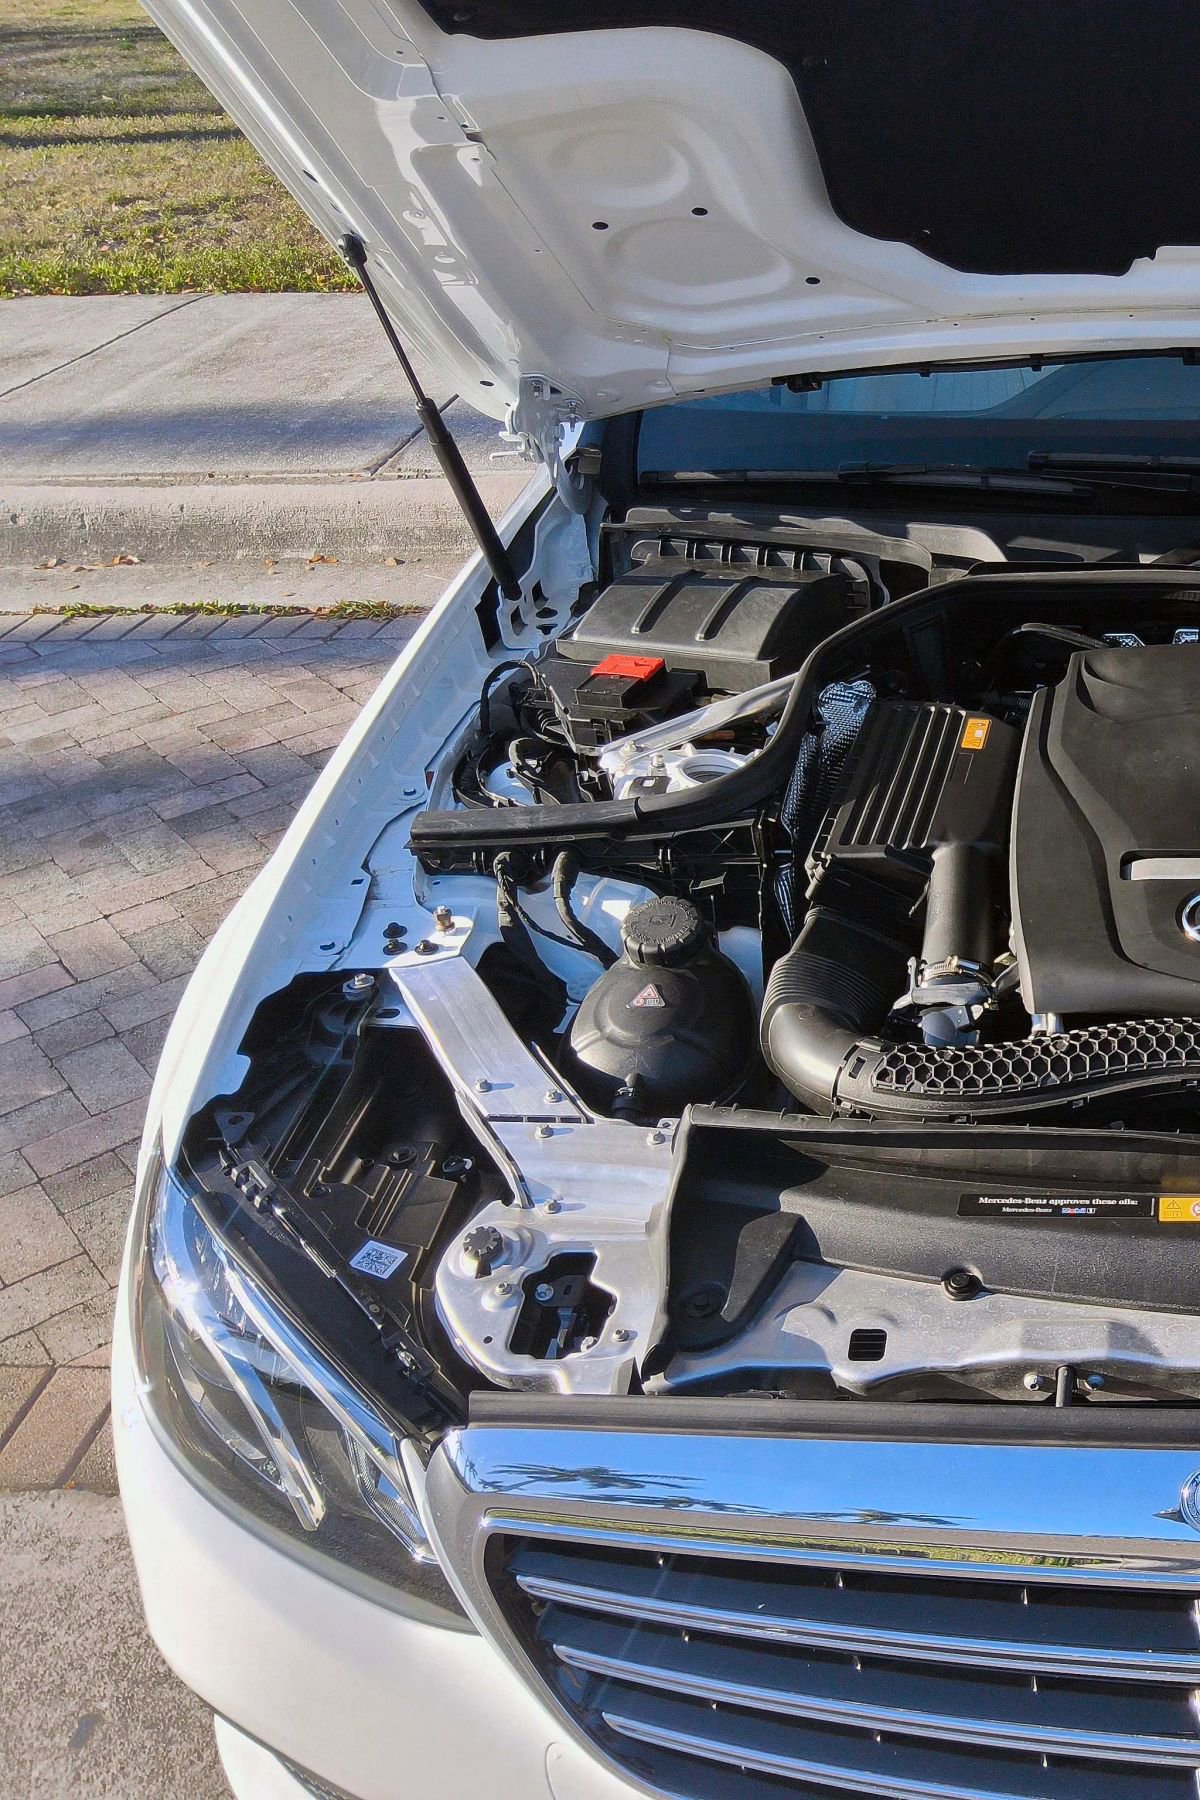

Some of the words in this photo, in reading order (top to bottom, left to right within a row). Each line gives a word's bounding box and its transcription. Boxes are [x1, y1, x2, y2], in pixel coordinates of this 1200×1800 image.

[978, 1197, 1048, 1205] Mercedes-Benz
[1048, 1198, 1090, 1206] approves
[1118, 1198, 1139, 1206] oils:
